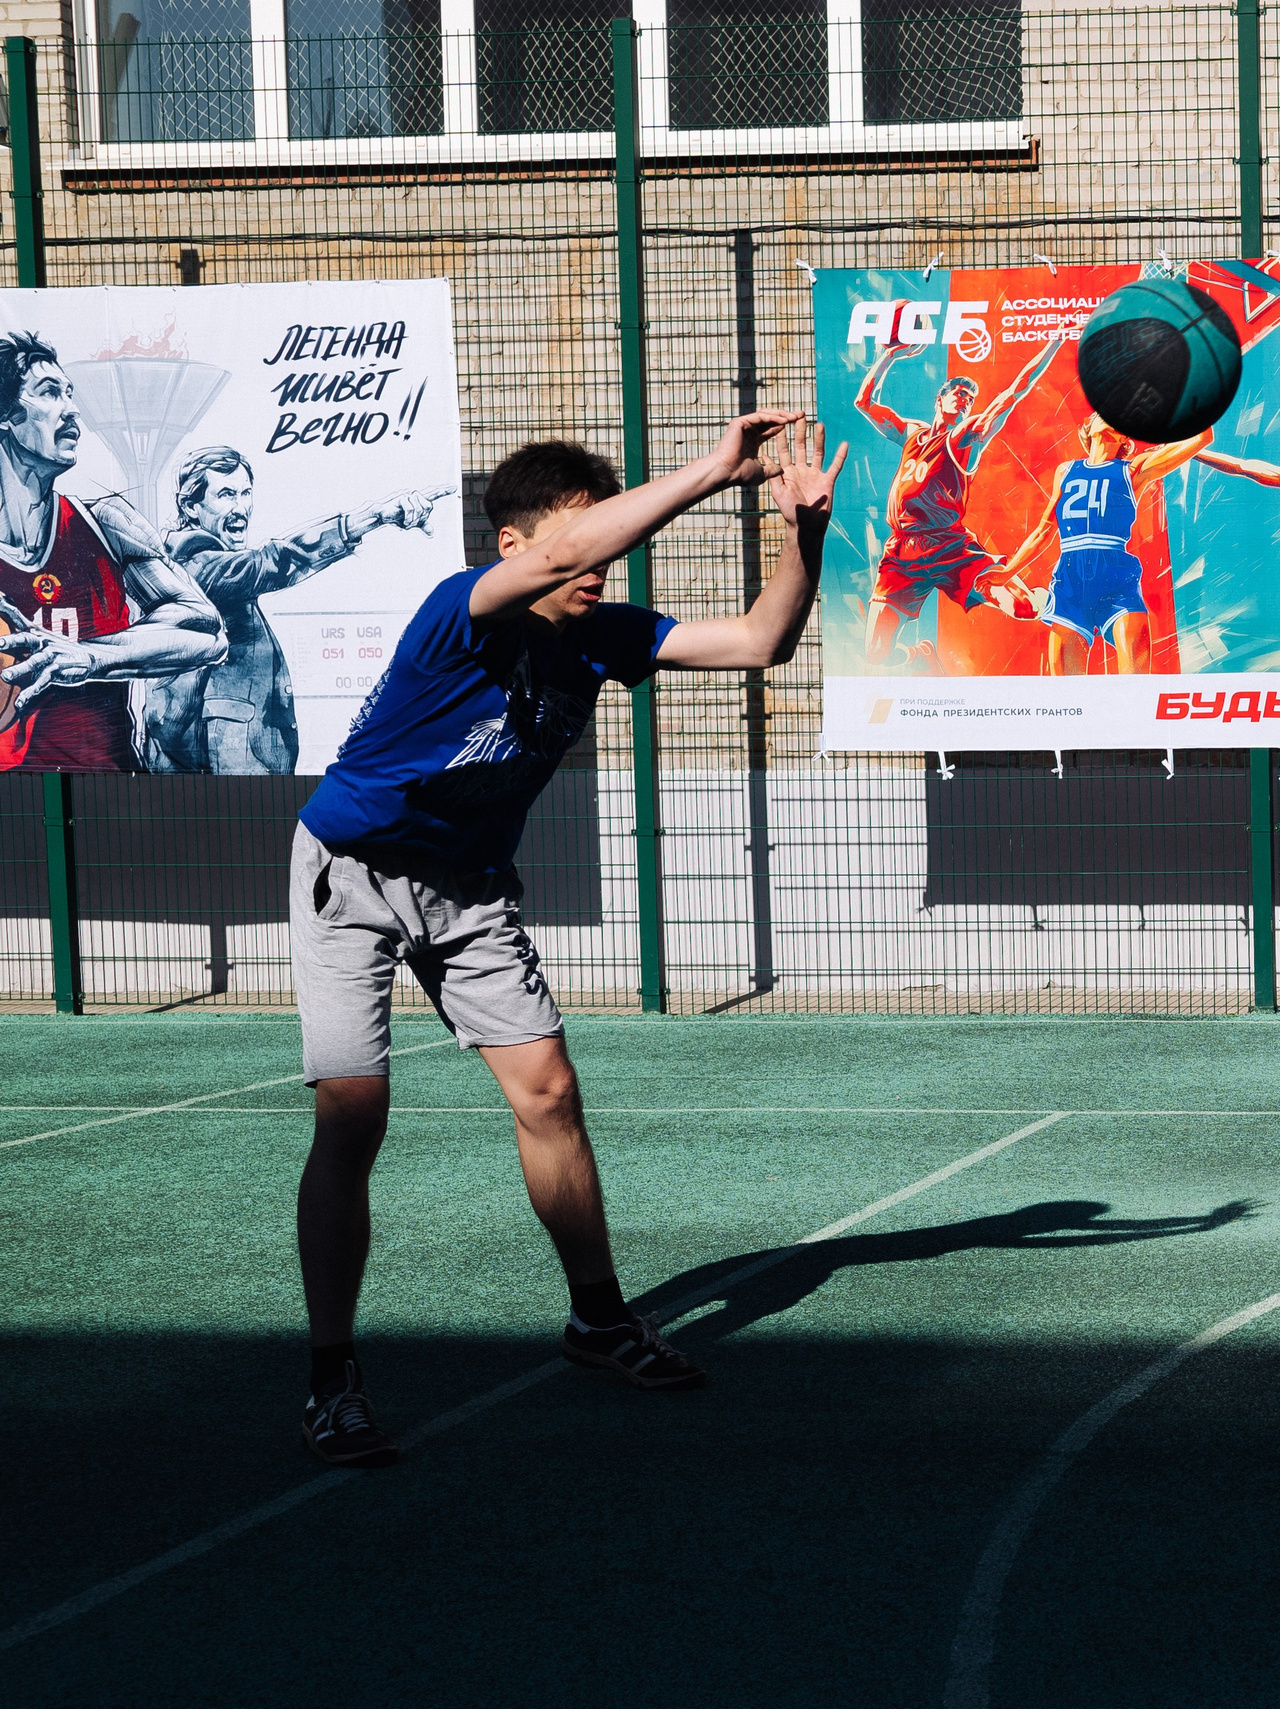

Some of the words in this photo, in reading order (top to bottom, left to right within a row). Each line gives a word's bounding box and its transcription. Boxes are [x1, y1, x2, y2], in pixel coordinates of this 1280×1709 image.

[846, 300, 992, 346] АСБ
[1001, 313, 1090, 327] СТУДЕНЧЕ
[263, 321, 409, 365] ЛЕГЕНДА
[1002, 329, 1084, 343] БАСКЕТБ
[901, 458, 928, 483] 20
[1062, 478, 1109, 519] 24
[321, 627, 345, 639] URS
[357, 626, 382, 638] USA
[322, 648, 344, 659] 051
[358, 647, 383, 658] 050
[917, 698, 965, 706] ПОДДЕРЖКЕ
[900, 708, 938, 717] ФОНДА
[943, 708, 1031, 717] ПРЕЗИДЕНТСКИХ
[1036, 707, 1083, 717] ГРАНТОВ
